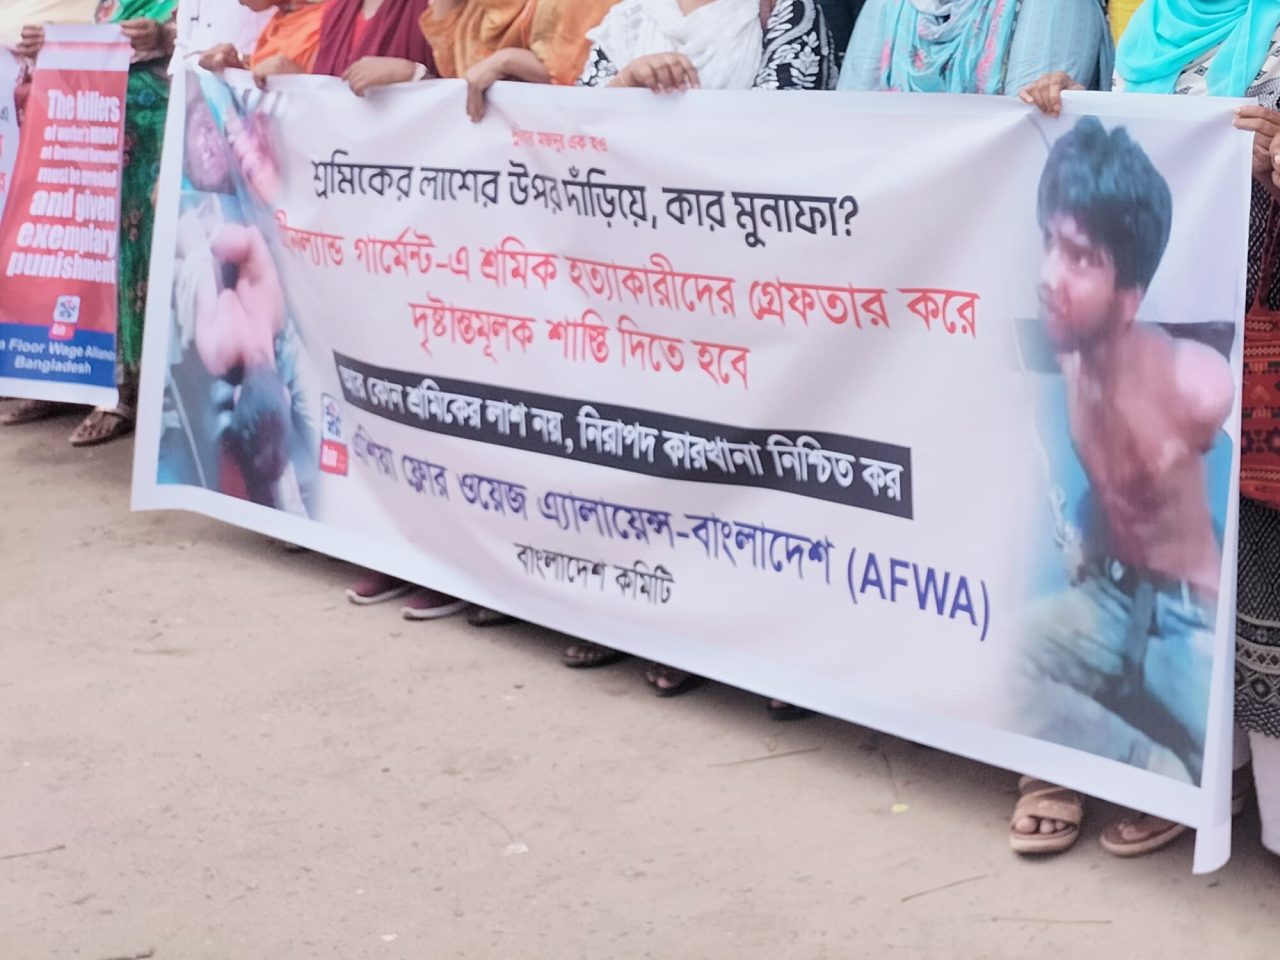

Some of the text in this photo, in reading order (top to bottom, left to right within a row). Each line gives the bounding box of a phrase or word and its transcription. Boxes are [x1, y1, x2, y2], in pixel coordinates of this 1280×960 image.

[48, 90, 74, 120] The
[16, 222, 116, 258] exemplary
[30, 188, 74, 218] and
[312, 150, 413, 201] শ্রমিকের
[420, 167, 501, 207] লাশের
[508, 160, 562, 213] উপর
[662, 187, 726, 232] কার
[731, 191, 859, 247] মুনাফা?
[480, 236, 558, 289] শ্রমিক
[564, 252, 736, 319] হত্যাকারীদের
[750, 277, 890, 329] গ্রেফতার
[898, 287, 980, 338] করে
[408, 292, 537, 362] দৃষ্টান্তমূলক
[618, 314, 686, 372] দিতে
[691, 339, 751, 390] হবে
[486, 398, 529, 438] লাশ
[576, 405, 659, 464] নিরাপদ
[662, 429, 764, 476] কারখানা
[766, 433, 854, 488] নিশ্চিত
[861, 456, 904, 501] কর
[513, 542, 676, 605] বাংলাদেশ কমিটি
[847, 547, 991, 642] (AFWA)
